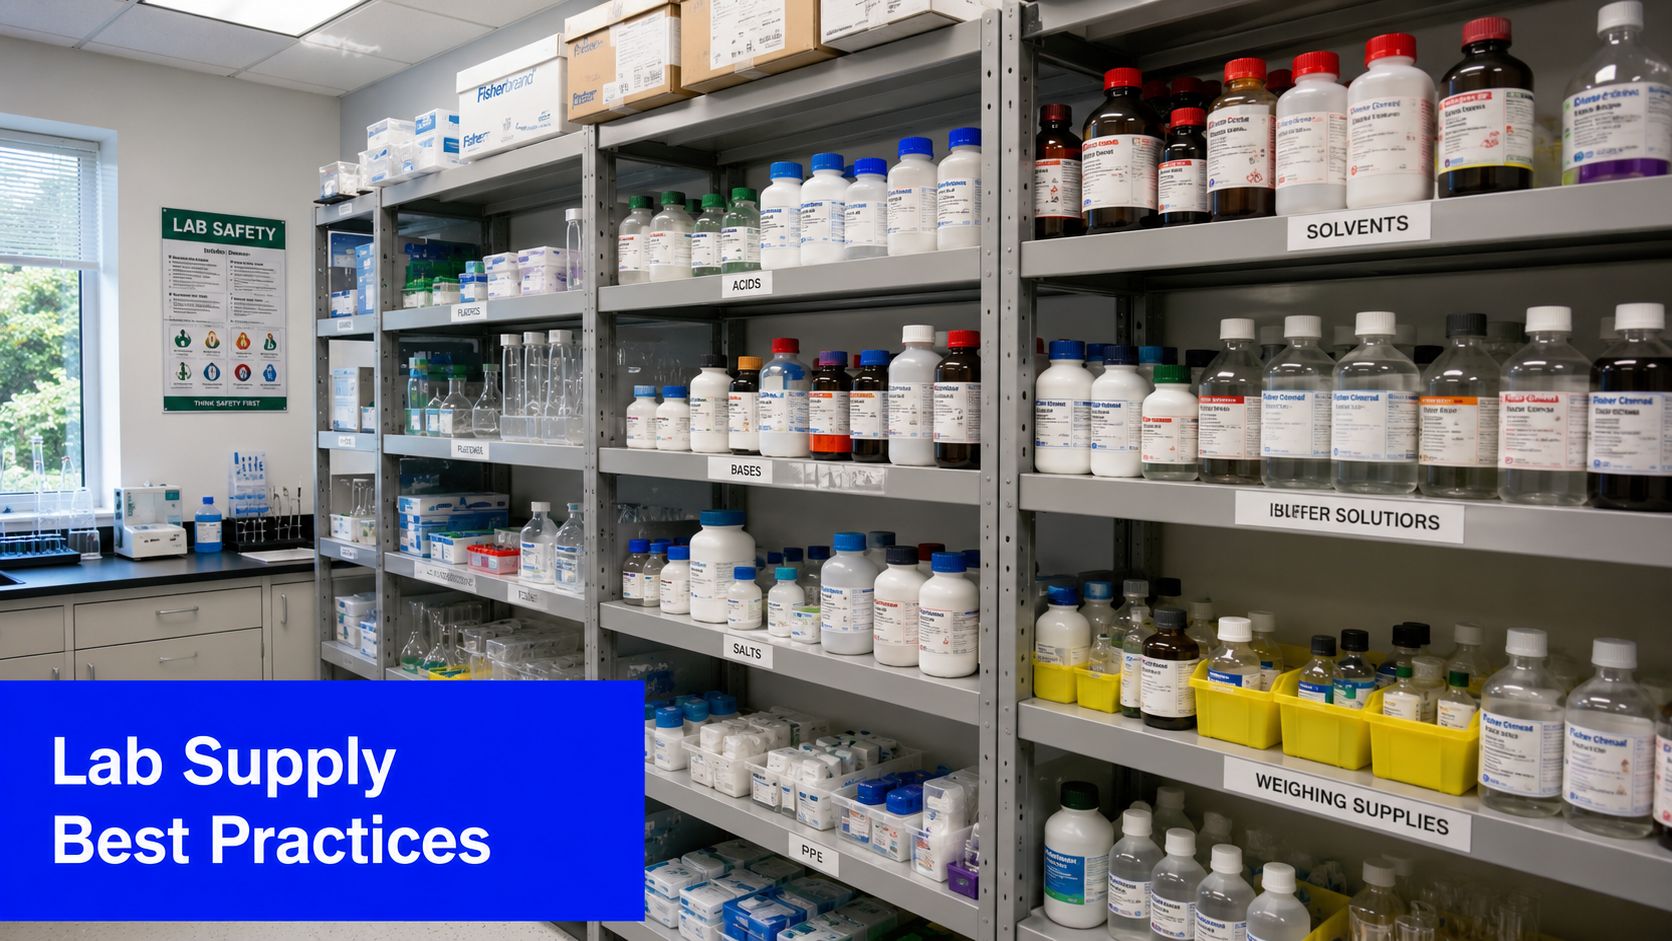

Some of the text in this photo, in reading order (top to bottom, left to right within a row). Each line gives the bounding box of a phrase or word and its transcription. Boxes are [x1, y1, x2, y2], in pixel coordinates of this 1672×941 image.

[477, 69, 535, 103] Fisherbrand
[173, 217, 276, 241] LAB SAFETY
[1307, 215, 1409, 239] SOLVENTS
[732, 277, 762, 291] ACIDS
[194, 400, 260, 408] THINK SAFETY FIRST
[731, 463, 762, 477] BASES
[733, 643, 762, 660] SALTS
[1256, 772, 1449, 836] WEIGHING SUPPLIES
[801, 844, 823, 864] PPE
